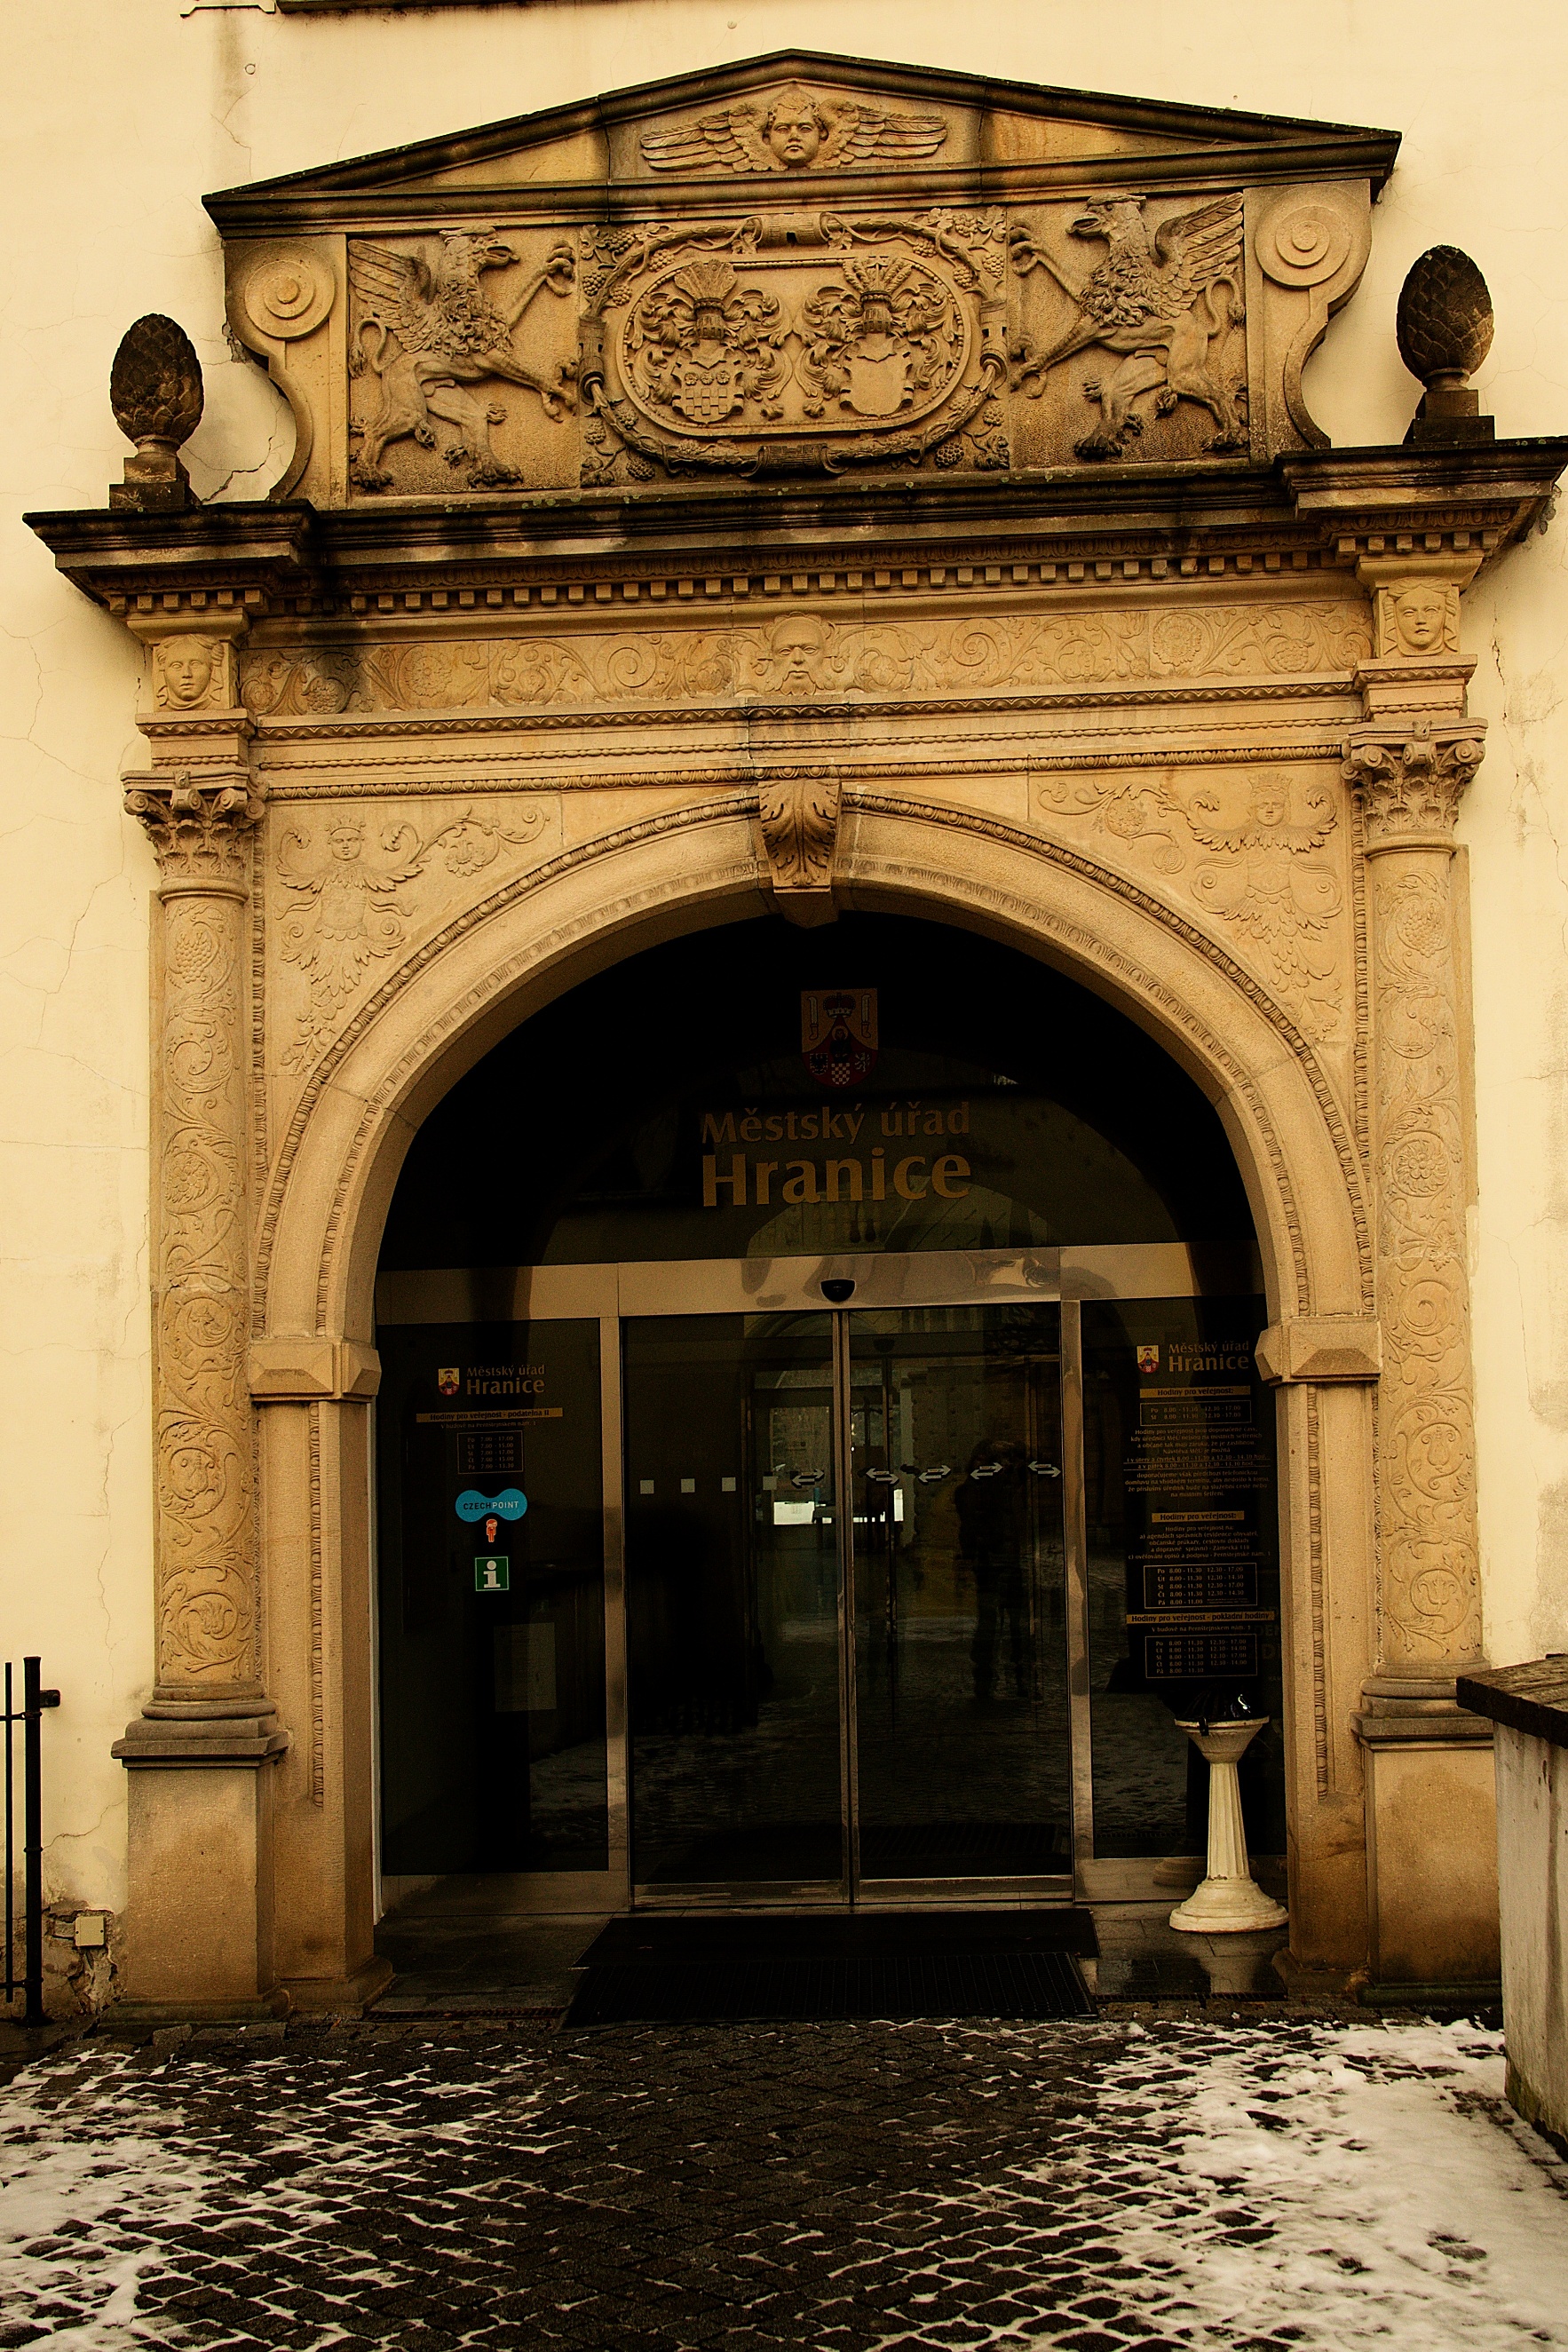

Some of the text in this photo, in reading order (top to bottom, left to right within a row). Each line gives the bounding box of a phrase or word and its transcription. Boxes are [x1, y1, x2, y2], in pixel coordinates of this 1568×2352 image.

[702, 1100, 970, 1144] Městský úřad
[701, 1147, 972, 1208] Hranice
[1168, 1341, 1249, 1355] Městský úřad
[467, 1364, 545, 1377] Městský úřad
[1168, 1354, 1249, 1373] Hranice
[467, 1377, 545, 1395] Hranice
[1172, 1613, 1206, 1622] veřejnost
[1212, 1612, 1242, 1621] pokladní
